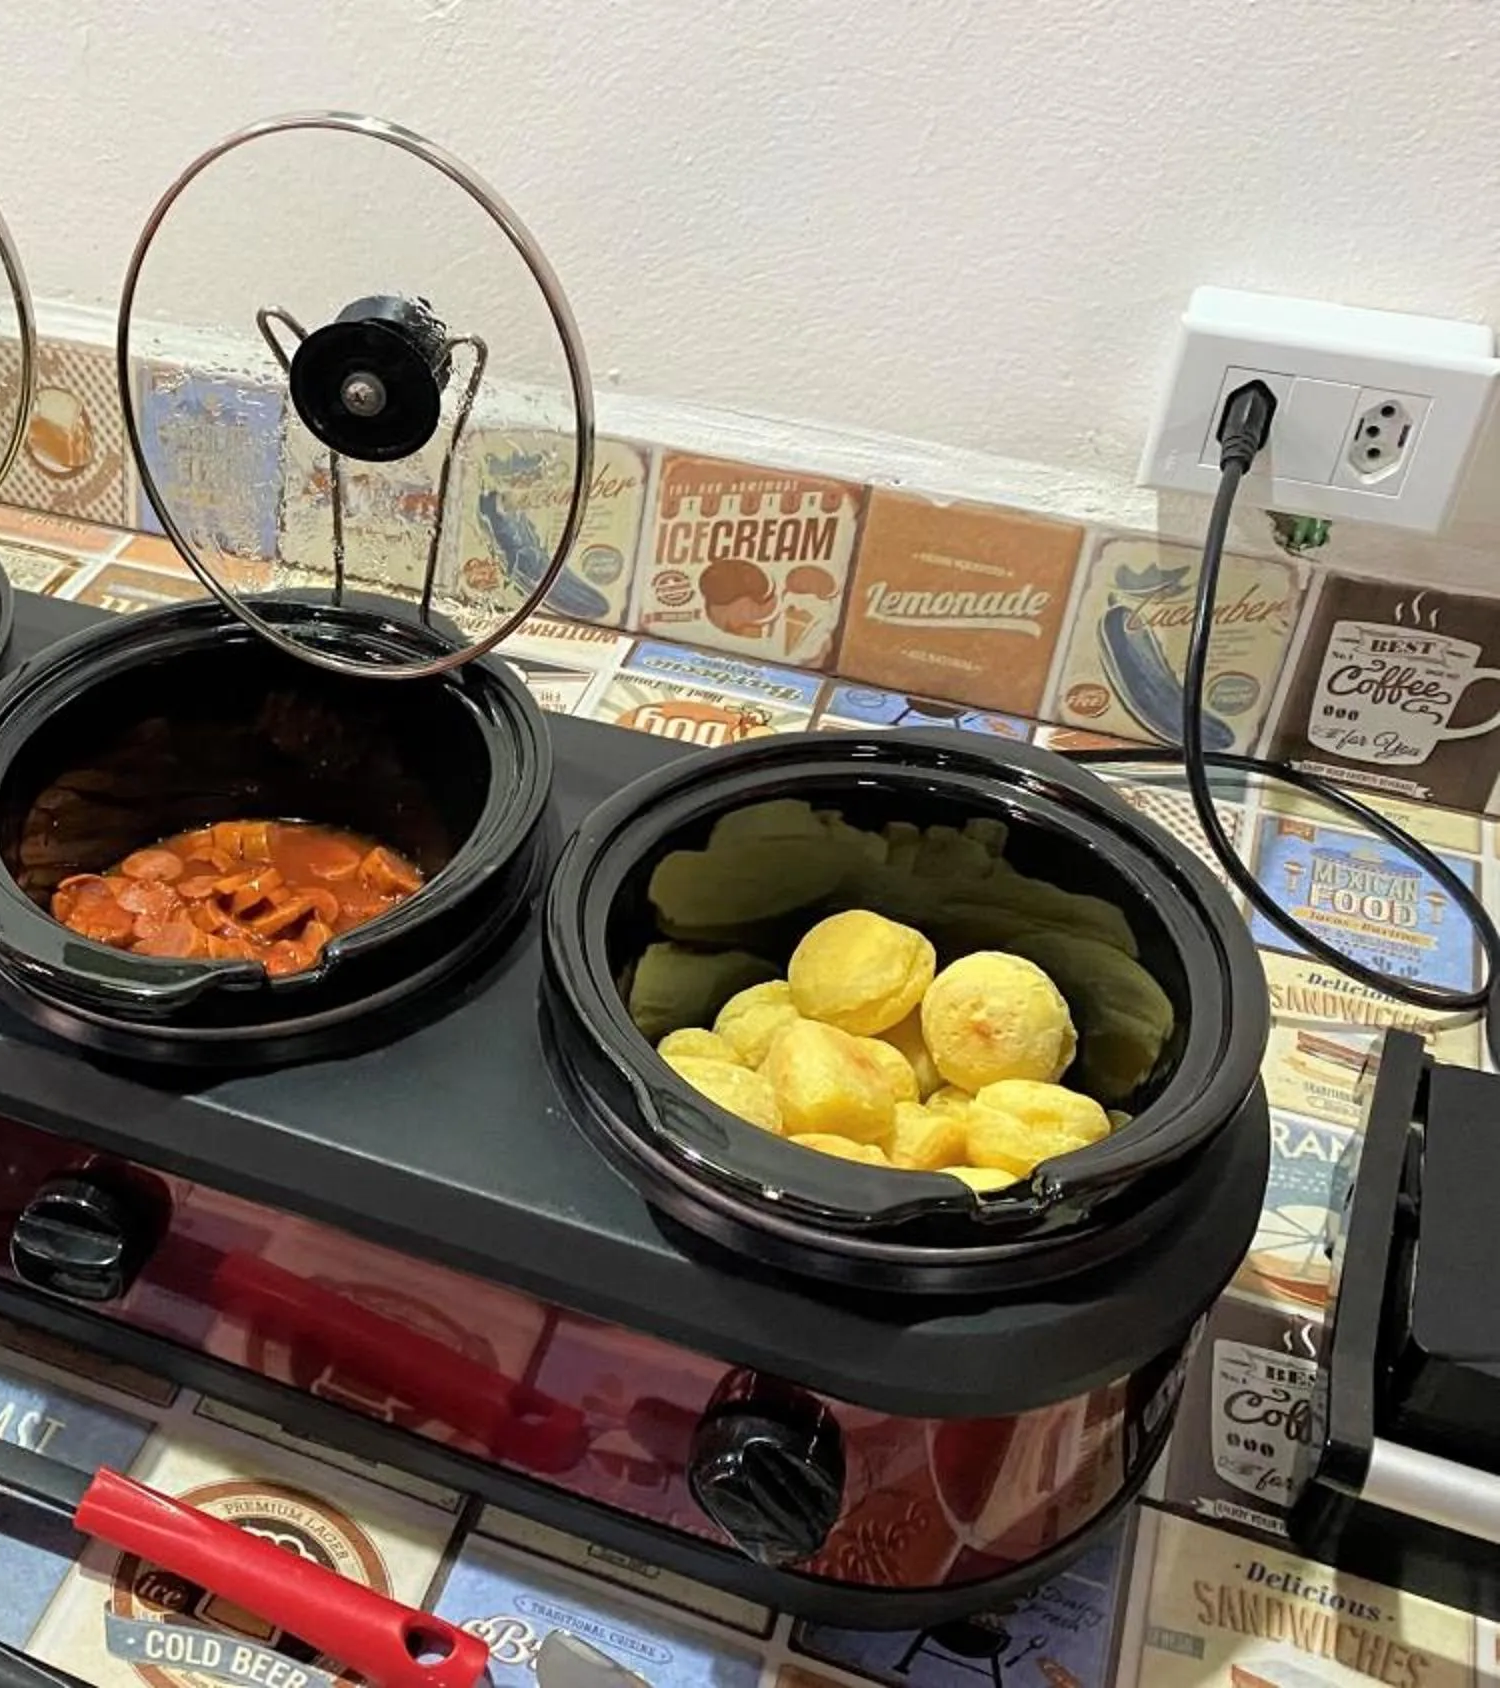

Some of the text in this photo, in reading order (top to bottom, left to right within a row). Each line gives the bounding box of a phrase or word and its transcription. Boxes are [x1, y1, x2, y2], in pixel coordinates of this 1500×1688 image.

[866, 581, 1051, 626] Lemonade
[1371, 639, 1436, 655] BEST
[1327, 662, 1452, 706] Coffee
[1336, 729, 1420, 758] for You
[1312, 857, 1419, 901] MEXICAN
[1309, 883, 1420, 928] FOOD
[1223, 1387, 1313, 1445] Coff
[222, 1499, 350, 1563] PREMIUM LAGER
[1246, 1560, 1382, 1623] Delicious
[1192, 1578, 1429, 1687] SANDWICHES
[145, 1629, 309, 1688] COLD BEER
